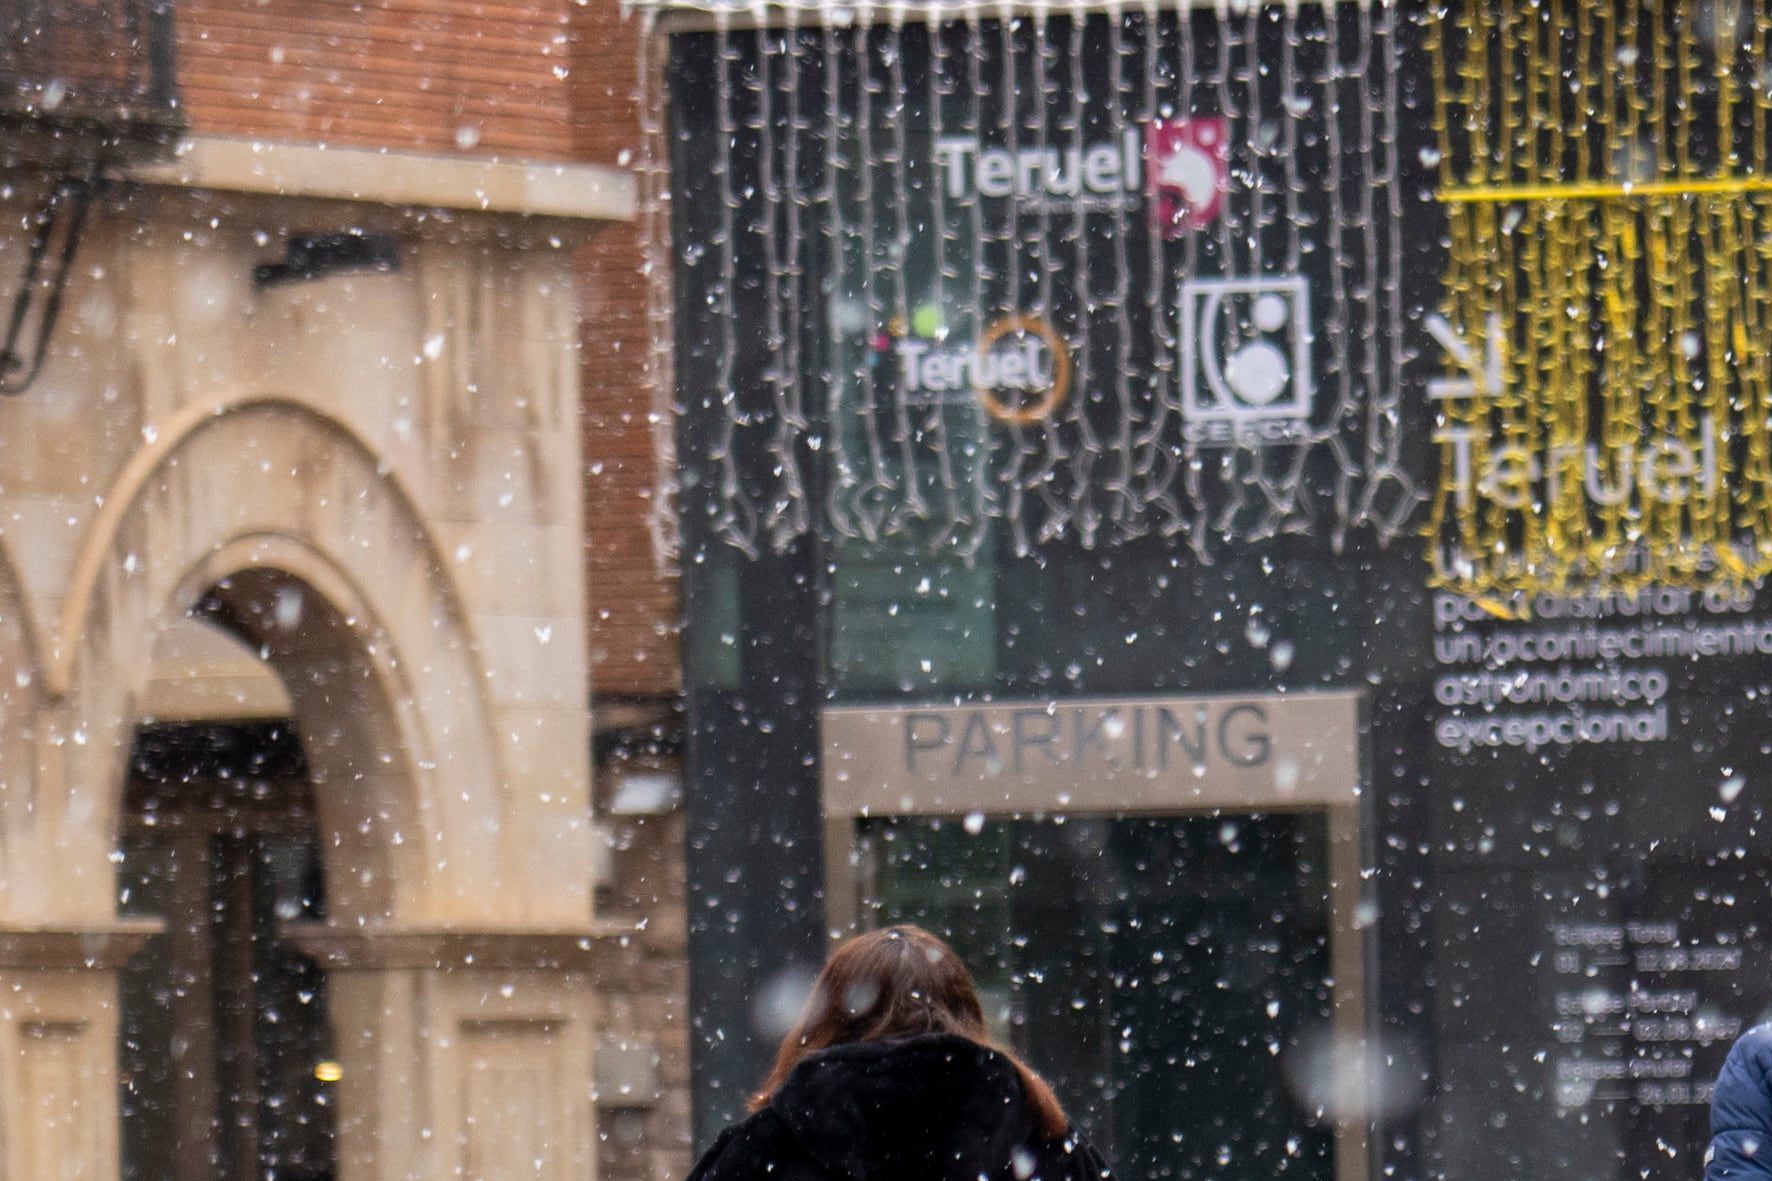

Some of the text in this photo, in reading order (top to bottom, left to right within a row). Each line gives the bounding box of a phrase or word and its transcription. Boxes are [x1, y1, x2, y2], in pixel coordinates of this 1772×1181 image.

[937, 130, 1142, 199] Teruel
[897, 337, 1047, 391] Teruel
[1435, 417, 1719, 508] Teruel
[1703, 578, 1755, 614] de
[1435, 633, 1483, 664] un
[1435, 666, 1669, 705] astronómico
[904, 705, 1274, 776] PARKING
[1435, 703, 1669, 750] excepcional
